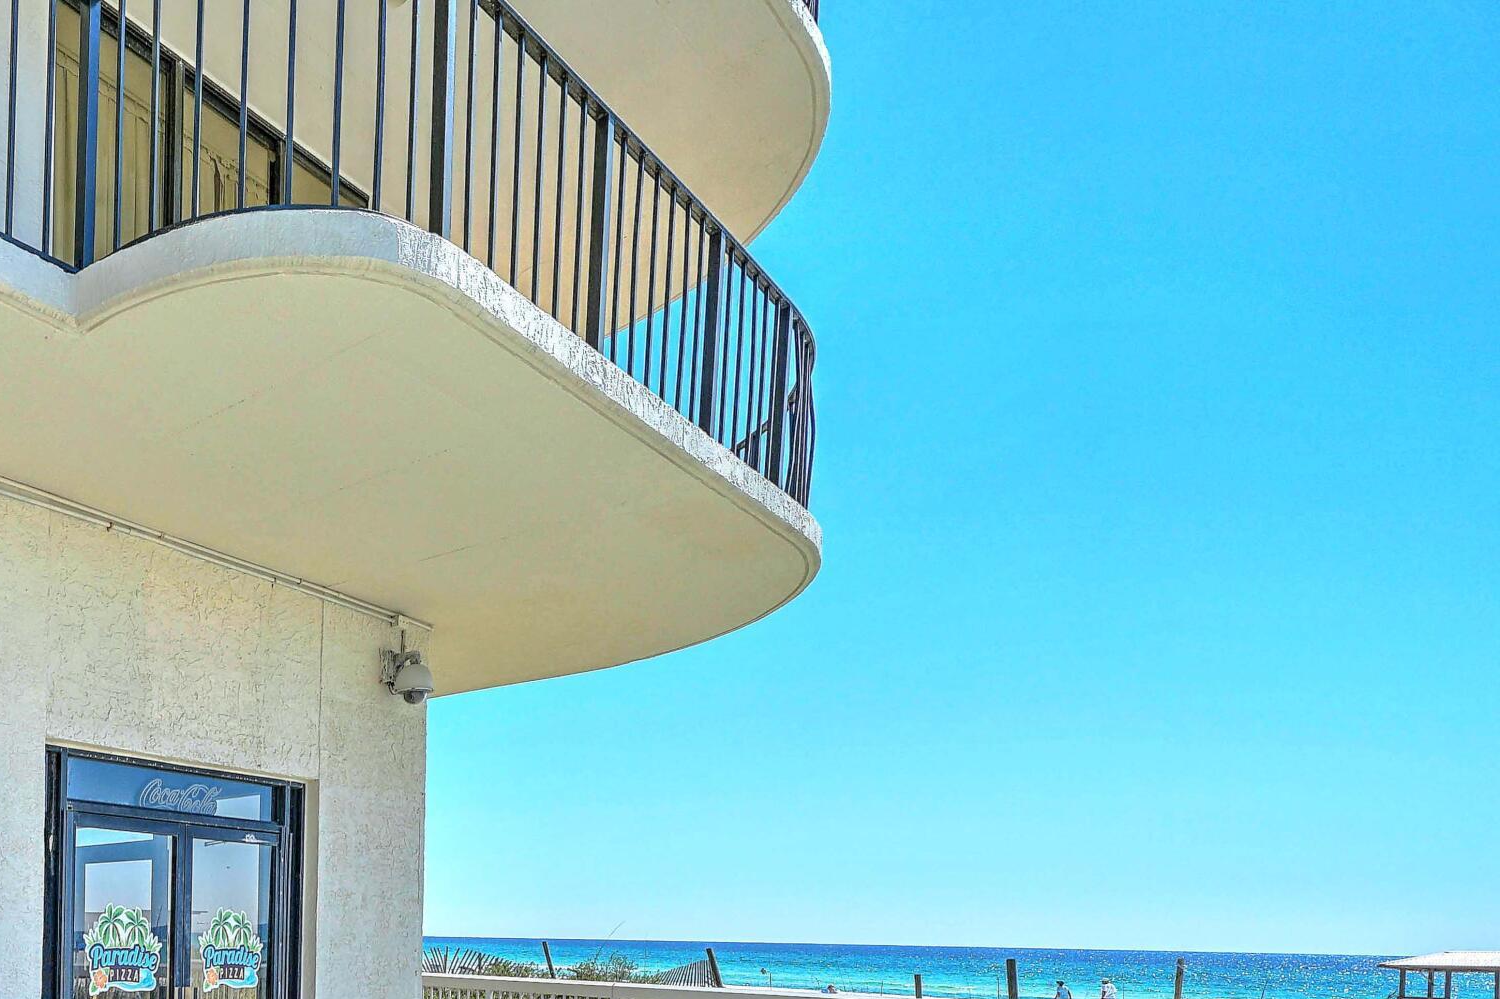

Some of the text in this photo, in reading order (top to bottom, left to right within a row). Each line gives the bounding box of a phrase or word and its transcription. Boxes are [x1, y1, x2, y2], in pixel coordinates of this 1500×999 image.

[89, 944, 159, 971] Paradise
[203, 944, 260, 970] Paradise
[109, 968, 139, 982] PIZZA
[219, 967, 244, 979] PIZZA
